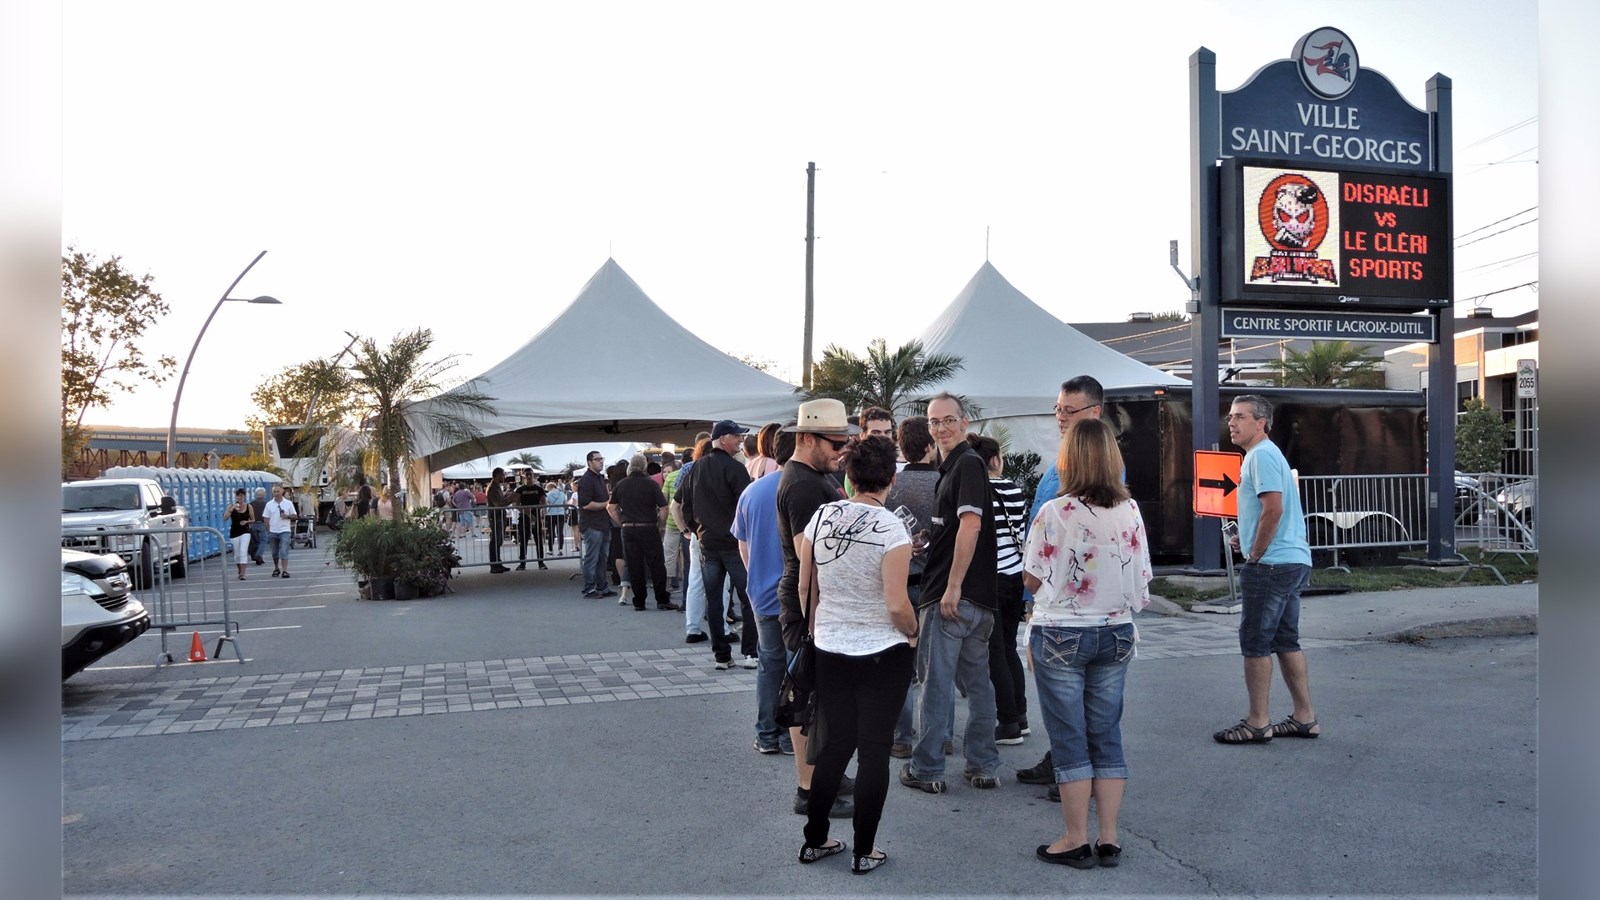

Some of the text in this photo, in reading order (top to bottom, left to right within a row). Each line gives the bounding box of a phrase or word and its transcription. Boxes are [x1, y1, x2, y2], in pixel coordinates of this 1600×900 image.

[1297, 102, 1360, 130] VILLE
[1231, 127, 1422, 165] SAINT-GEORGES
[1344, 231, 1367, 251] LE
[1350, 258, 1423, 280] SPORTS
[1233, 316, 1424, 334] CENTRE SPORTIF LACROIX-DUTIL
